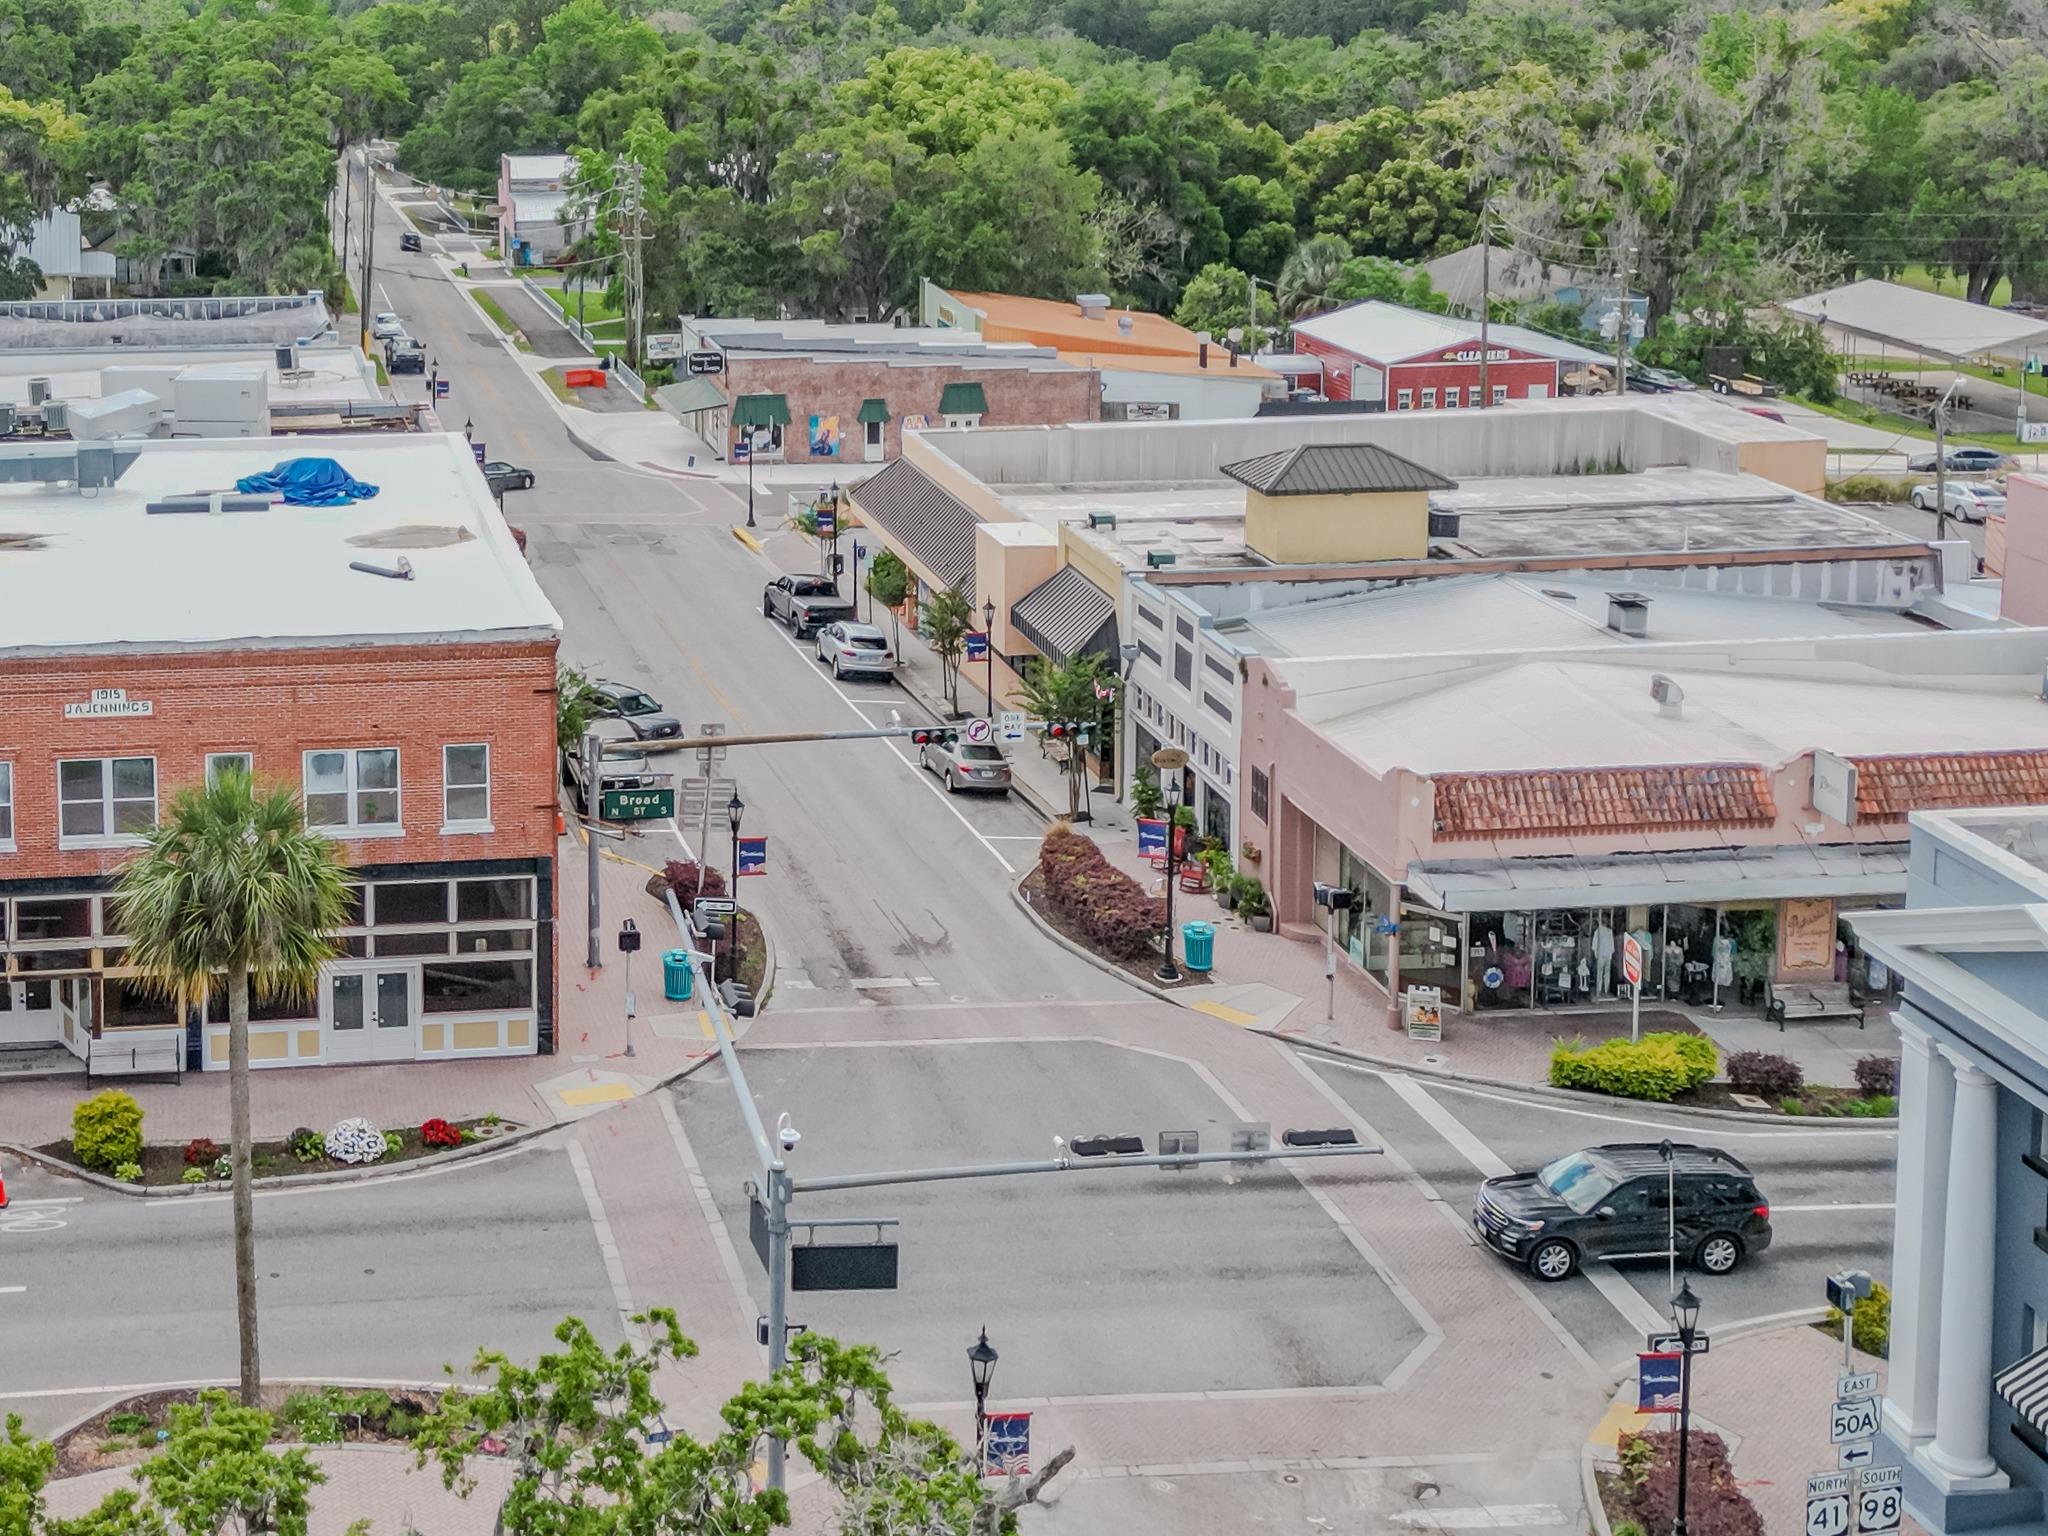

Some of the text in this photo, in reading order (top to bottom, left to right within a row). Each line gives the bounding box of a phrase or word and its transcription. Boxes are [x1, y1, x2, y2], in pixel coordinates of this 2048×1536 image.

[619, 794, 660, 805] Broad
[611, 806, 667, 816] N ST S
[1844, 1378, 1871, 1393] EAST
[1835, 1412, 1873, 1436] 50A
[1863, 1470, 1900, 1485] SOUTH
[1809, 1478, 1848, 1493] NORTH
[1864, 1496, 1897, 1520] 98
[1813, 1505, 1839, 1528] 41
